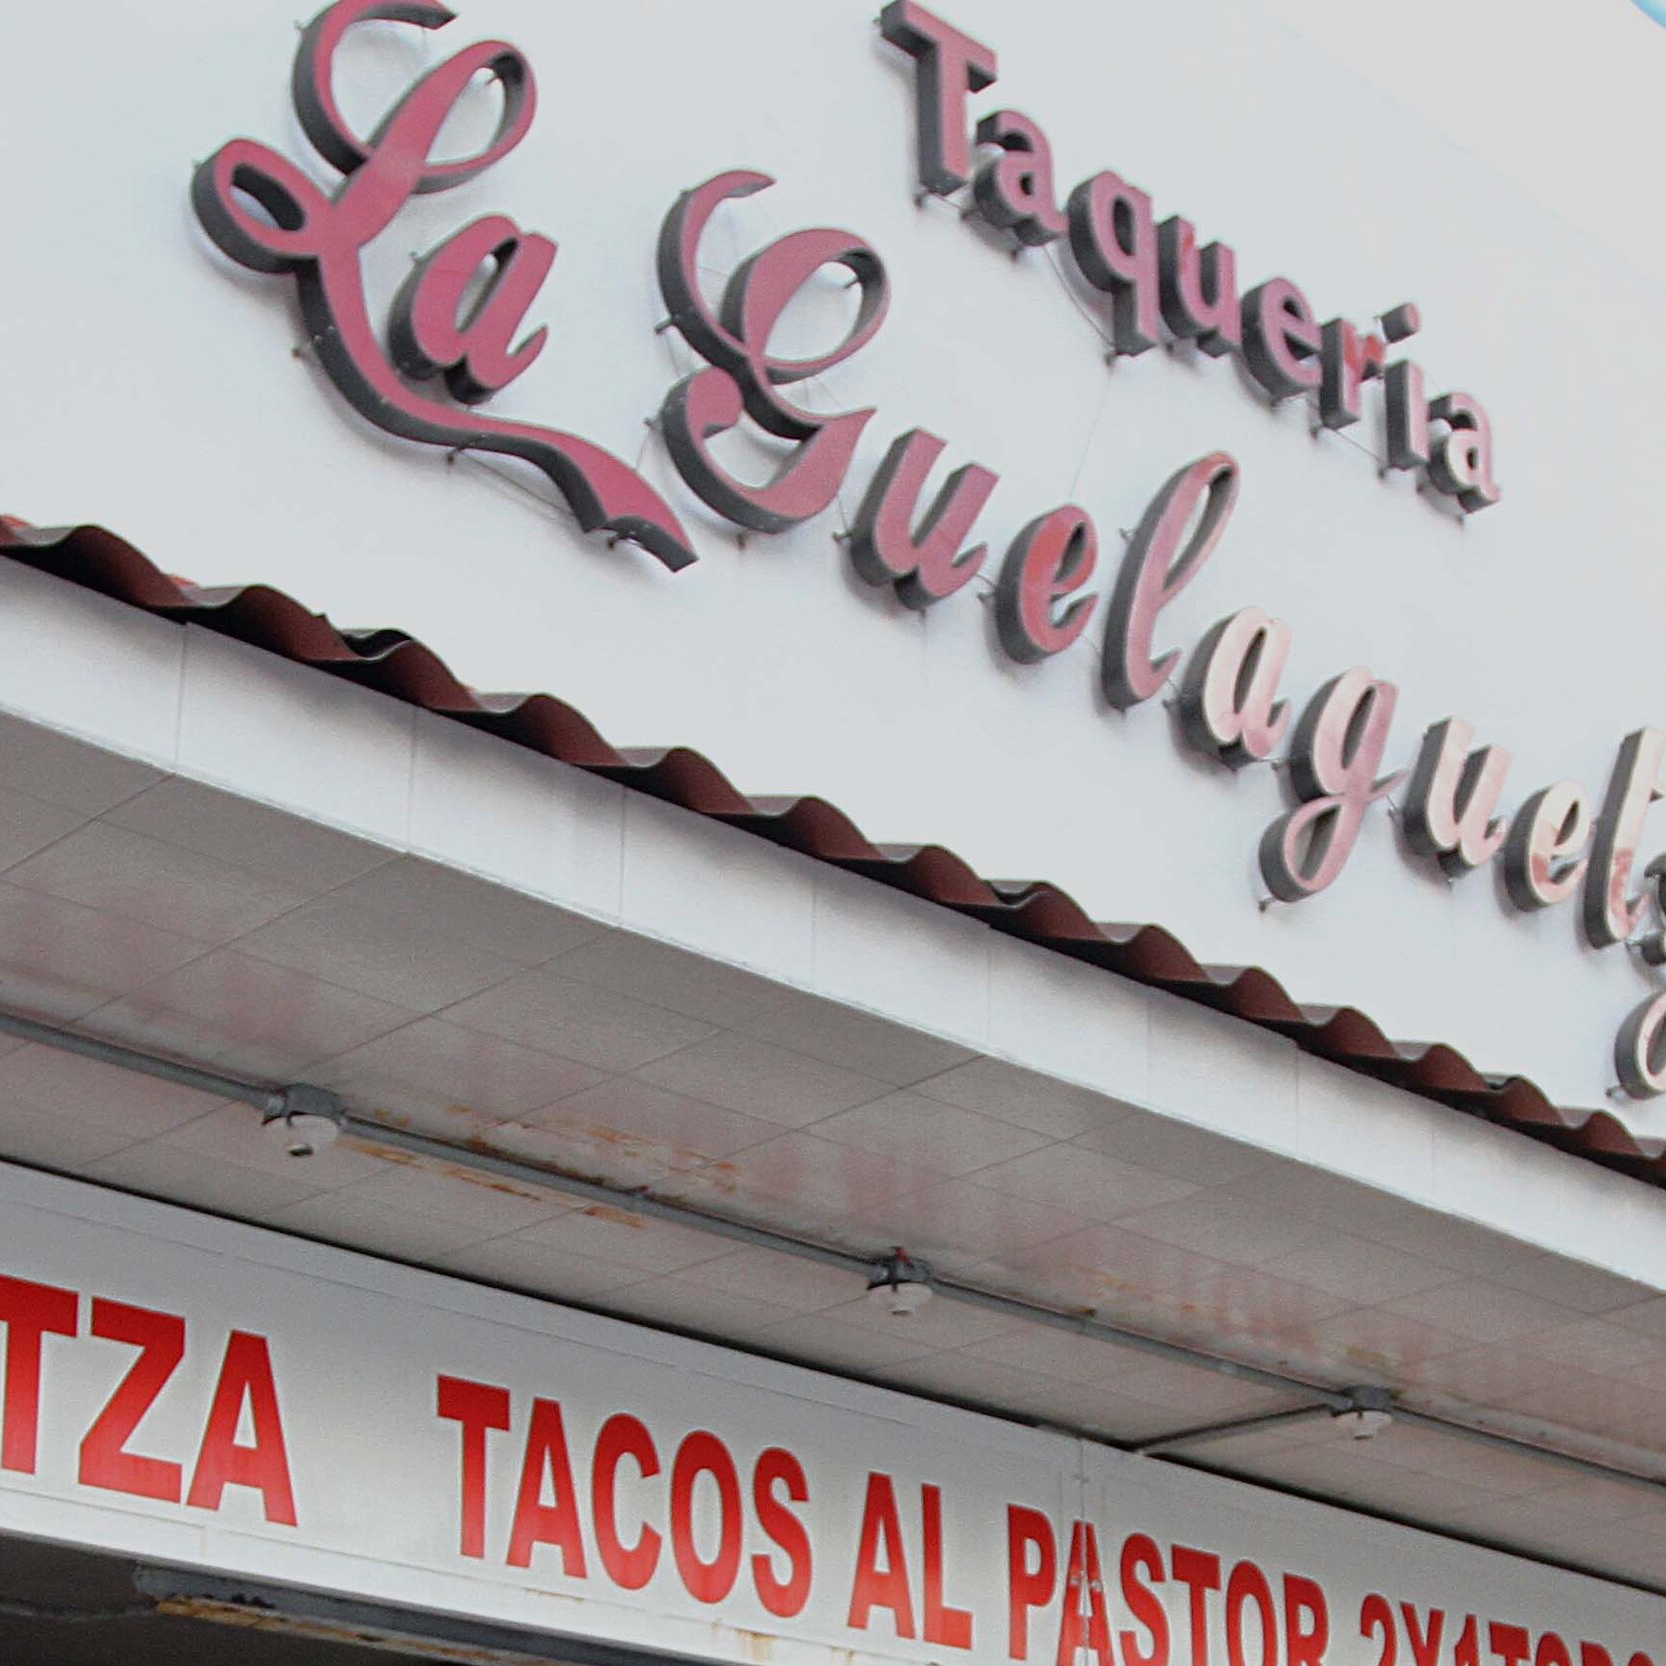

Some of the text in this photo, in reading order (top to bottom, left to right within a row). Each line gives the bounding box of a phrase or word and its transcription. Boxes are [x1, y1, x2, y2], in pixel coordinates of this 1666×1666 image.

[190, 0, 699, 573] La
[880, 0, 1501, 515] Taqueria
[436, 1373, 814, 1619] TACOS
[846, 1471, 973, 1650] AL
